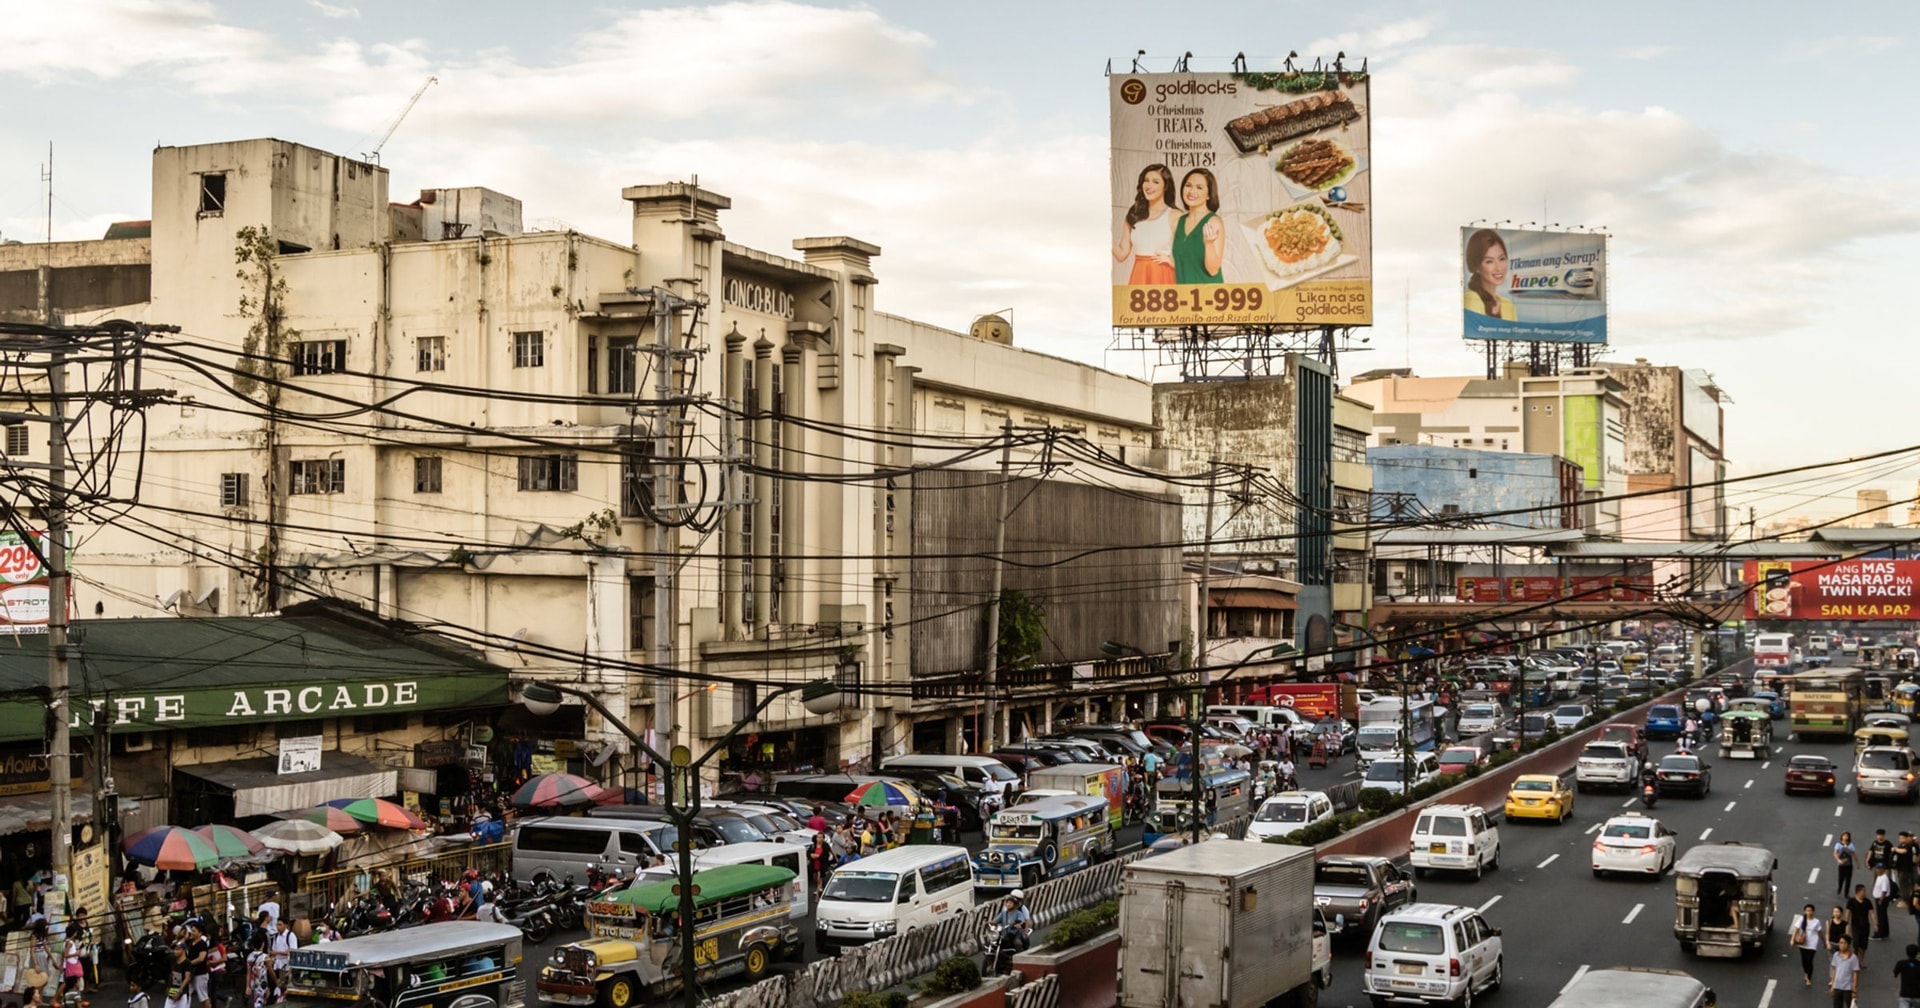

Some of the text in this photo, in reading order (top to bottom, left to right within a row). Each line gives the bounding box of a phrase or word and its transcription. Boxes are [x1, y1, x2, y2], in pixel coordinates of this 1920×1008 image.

[1156, 80, 1237, 103] goldilocks
[1147, 104, 1204, 116] O Christmas
[1155, 117, 1208, 133] TREATS.
[1155, 138, 1212, 150] O Christmas
[1163, 151, 1216, 167] TREATS!
[1509, 248, 1600, 270] Tikman ang Sarap!
[1130, 287, 1263, 313] 888-1-999
[1329, 294, 1346, 303] na
[1349, 293, 1365, 302] sa
[1119, 313, 1277, 324] for Metro Manila and Rizal only
[1296, 303, 1365, 321] goldilocks
[0, 546, 39, 574] 295
[1835, 562, 1896, 574] ANG MAS
[1818, 574, 1912, 585] MASARAP NA
[1820, 585, 1912, 596] TWIN PACK!
[1821, 604, 1911, 615] SAN KA PA?
[226, 682, 417, 716] ARCADE
